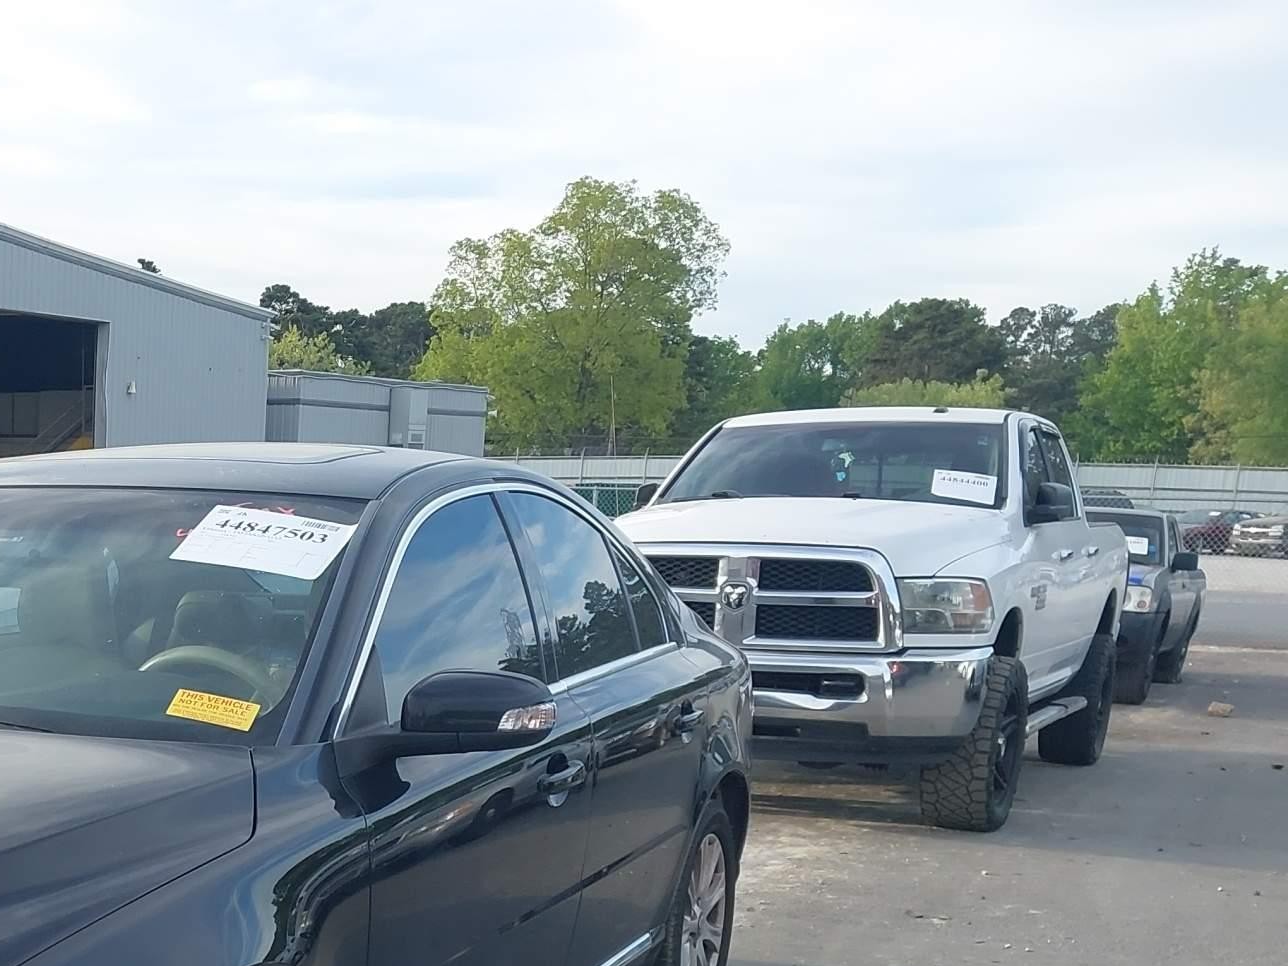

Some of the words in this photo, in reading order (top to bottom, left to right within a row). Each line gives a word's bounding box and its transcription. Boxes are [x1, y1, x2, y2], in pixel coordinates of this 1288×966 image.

[215, 518, 329, 544] 44847503
[178, 698, 198, 706] NOT
[199, 702, 220, 711] FOR
[223, 706, 248, 717] SALE
[180, 691, 205, 701] THIS
[207, 695, 253, 711] VEHICLE
